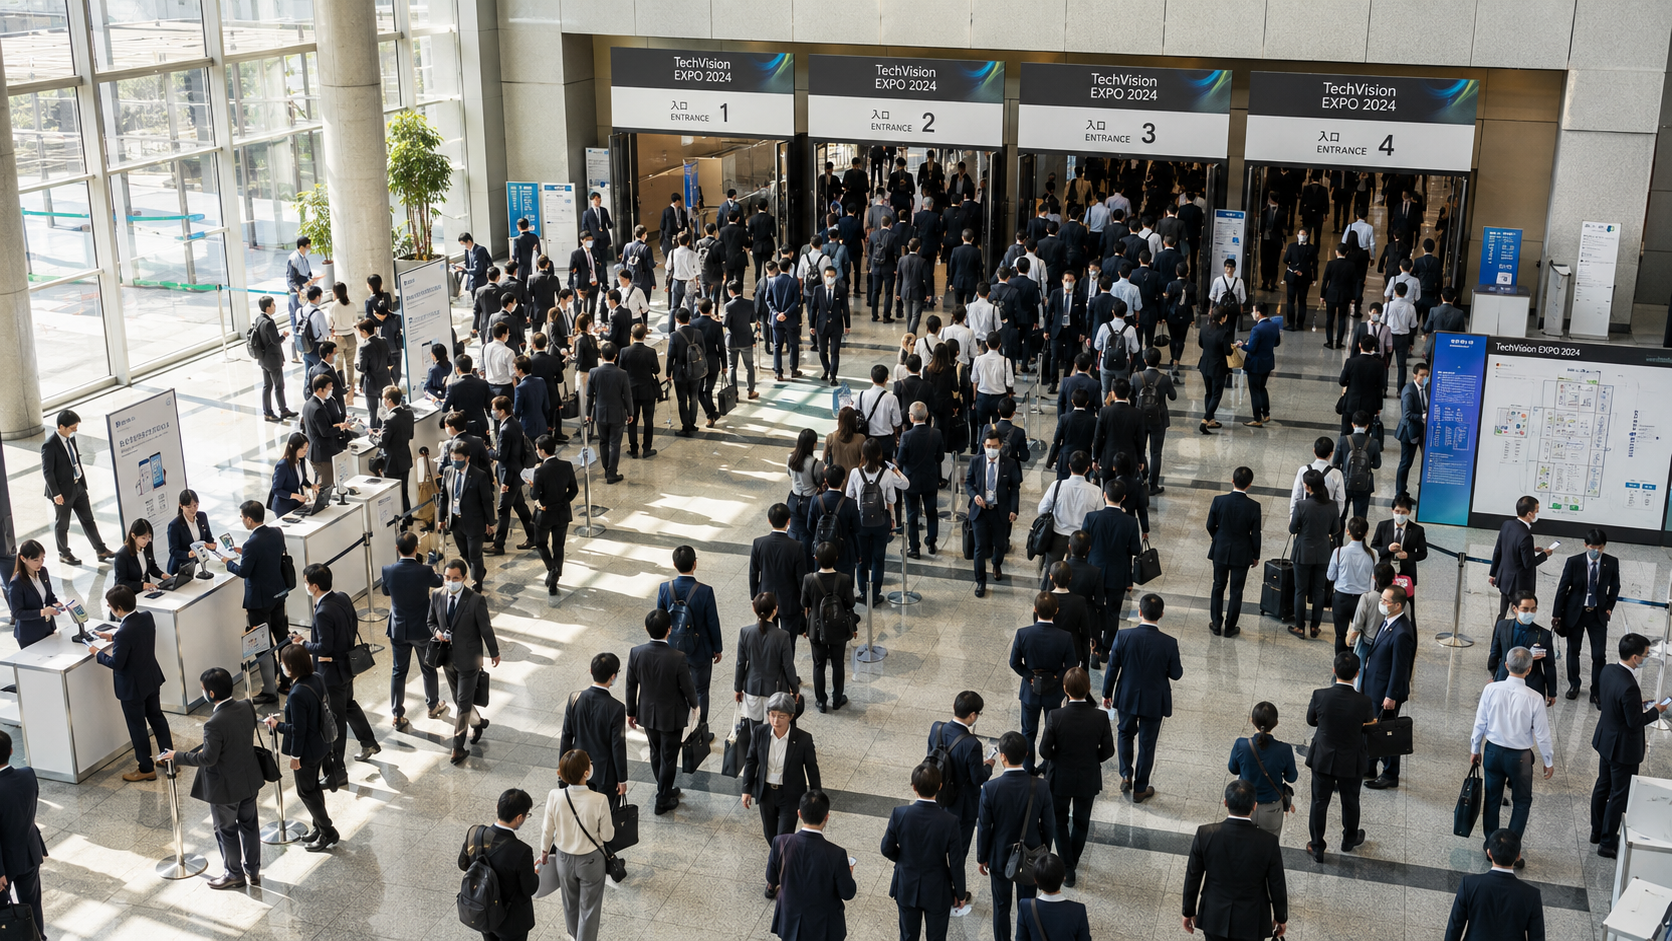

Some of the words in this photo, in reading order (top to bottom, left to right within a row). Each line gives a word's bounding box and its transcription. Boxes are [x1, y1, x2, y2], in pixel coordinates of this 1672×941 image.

[674, 56, 731, 69] TechVision
[674, 70, 703, 81] EXPO
[706, 71, 732, 82] 2024
[875, 64, 936, 78] TechVision
[875, 79, 906, 90] EXPO
[909, 80, 937, 91] 2024
[1091, 73, 1158, 87] TechVision
[1090, 87, 1124, 100] EXPO
[1127, 89, 1158, 101] 2024
[1323, 82, 1397, 97] TechVision
[671, 101, 688, 110] 入口
[1322, 97, 1359, 110] EXPO
[1362, 99, 1397, 111] 2024
[671, 114, 709, 122] ENTRANCE
[720, 103, 728, 122] 1
[871, 110, 890, 120] 入口
[871, 123, 912, 132] ENTRANCE
[922, 112, 935, 133] 2
[1086, 120, 1106, 131] 入口
[1085, 133, 1131, 143] ENTRANCE
[1141, 122, 1156, 144] 3
[1318, 131, 1340, 142] 入口
[1316, 145, 1367, 155] ENTRANCE
[1378, 134, 1395, 156] 4
[1538, 345, 1560, 355] EXPO
[1561, 347, 1580, 356] 2024
